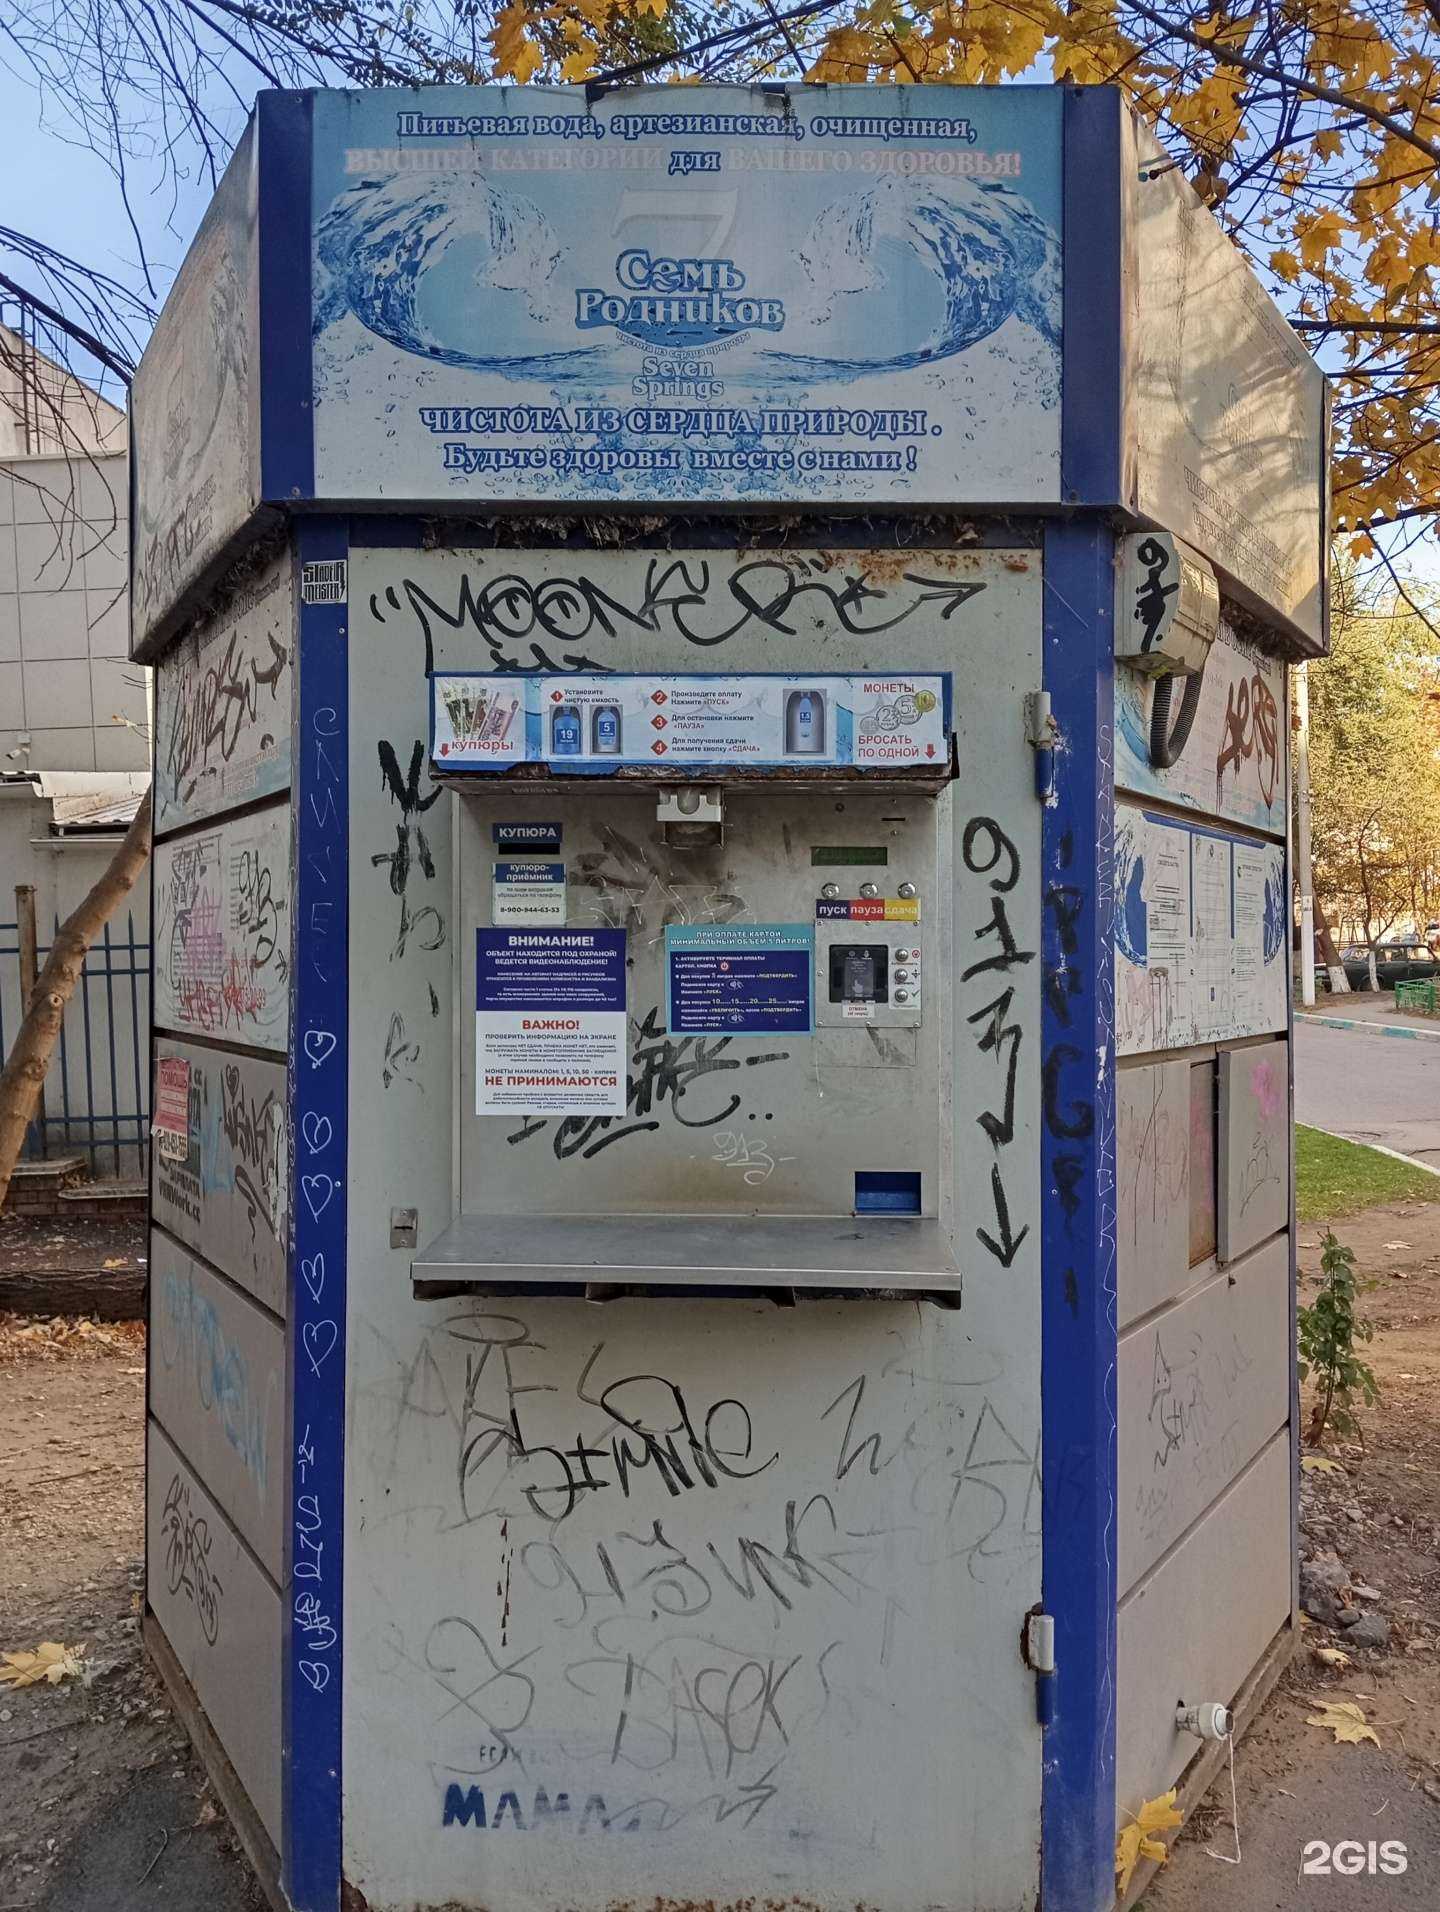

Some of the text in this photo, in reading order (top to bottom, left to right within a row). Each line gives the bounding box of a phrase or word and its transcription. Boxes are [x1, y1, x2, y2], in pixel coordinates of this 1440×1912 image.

[398, 112, 977, 142] Питьевая вода, артезианская, очищенная,
[345, 146, 1022, 177] ВЫСШЕЙ КАТЕГОРИИ для ВАШЕГО ЗДОРОВЬЯ!
[616, 249, 746, 293] Семь
[576, 289, 785, 330] Родников
[642, 356, 715, 378] Seven
[632, 376, 724, 401] Springs
[420, 407, 571, 434] ЧИСТОТА
[575, 408, 622, 434] ИЗ
[626, 408, 754, 439] СЕРДЦА
[444, 443, 548, 473] Будьте
[550, 448, 680, 474] здоровы
[693, 450, 794, 470] вместе
[798, 451, 817, 469] с
[864, 684, 915, 693] МОНЕТЫ
[604, 723, 611, 732] 5
[560, 730, 573, 739] 19
[858, 735, 912, 744] БРОСАТЬ
[452, 740, 513, 754] купюры
[858, 746, 919, 758] ПО ОДНОЙ
[499, 828, 557, 838] КУПЮРА
[510, 864, 550, 872] купюро-
[507, 872, 554, 882] приёмник
[820, 905, 847, 916] пуск
[850, 905, 884, 916] пауза
[508, 936, 594, 946] ВНИМАНИЕ!
[522, 1020, 580, 1030] ВАЖНО!
[485, 1076, 617, 1086] НЕ ПРИНИМАЮТСЯ
